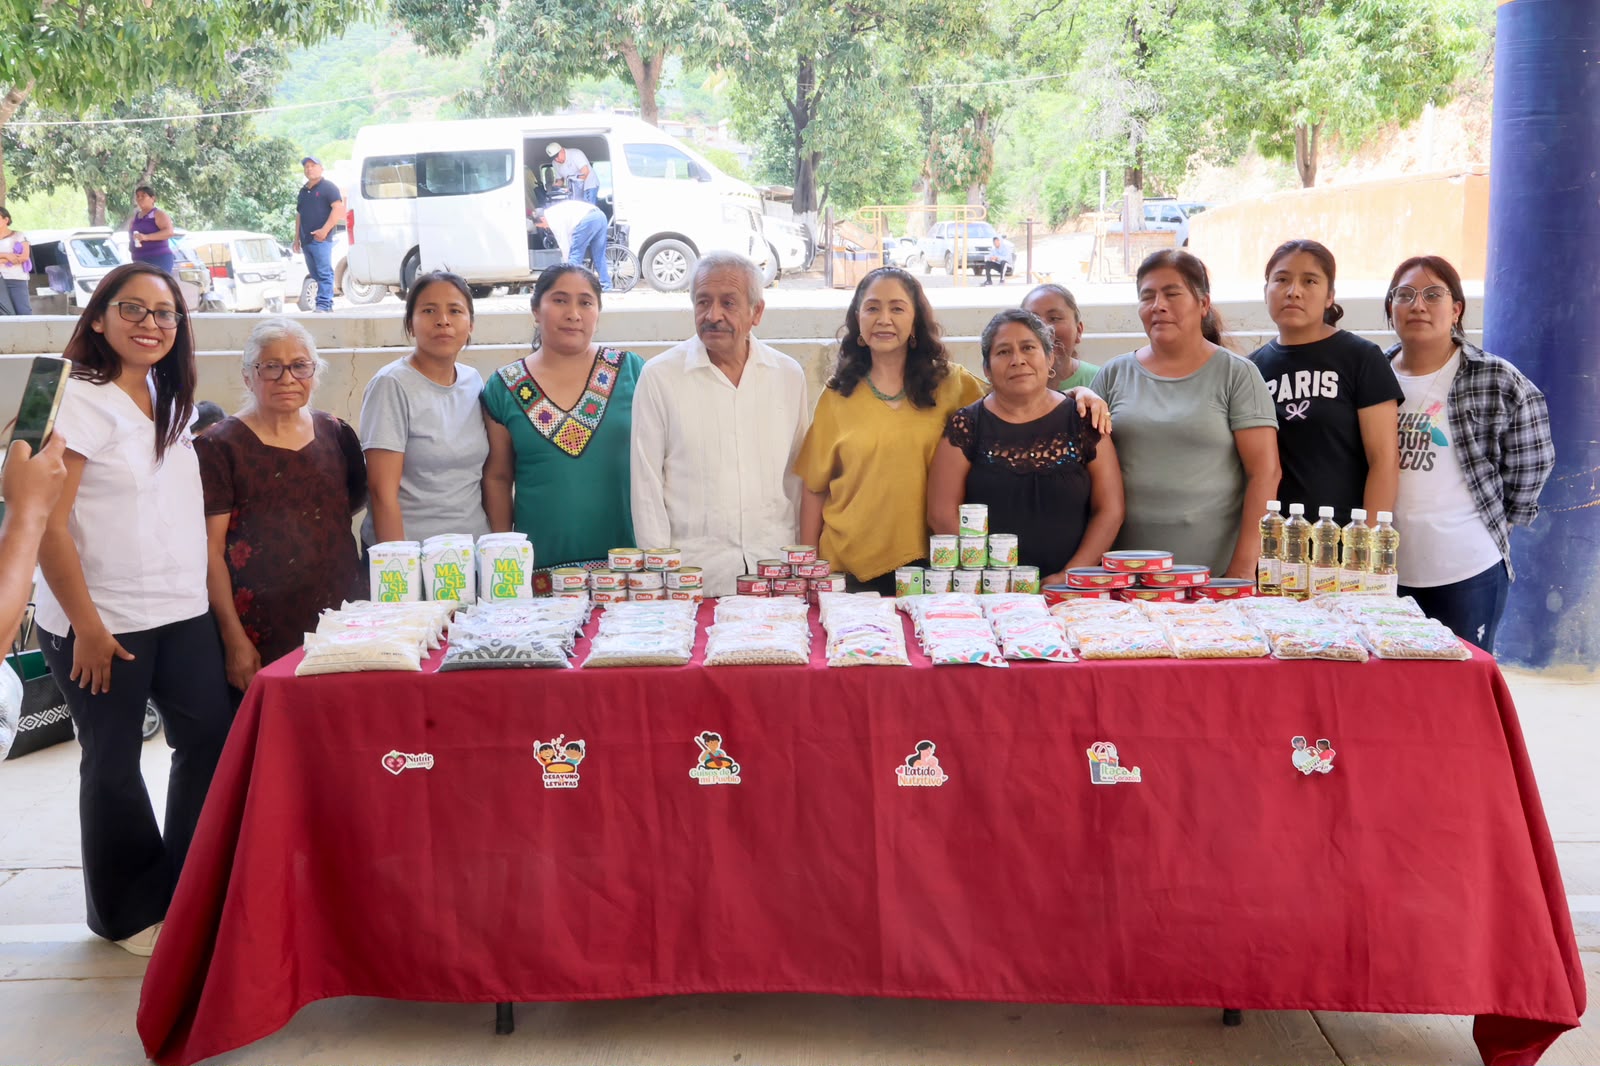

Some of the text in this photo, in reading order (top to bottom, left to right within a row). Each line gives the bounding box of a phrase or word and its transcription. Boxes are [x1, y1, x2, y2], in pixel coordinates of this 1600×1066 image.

[1266, 370, 1339, 403] PARIS
[1398, 431, 1431, 450] OUR
[690, 768, 730, 777] Guisos de
[904, 766, 936, 776] Latido
[899, 775, 942, 785] Nutritivo
